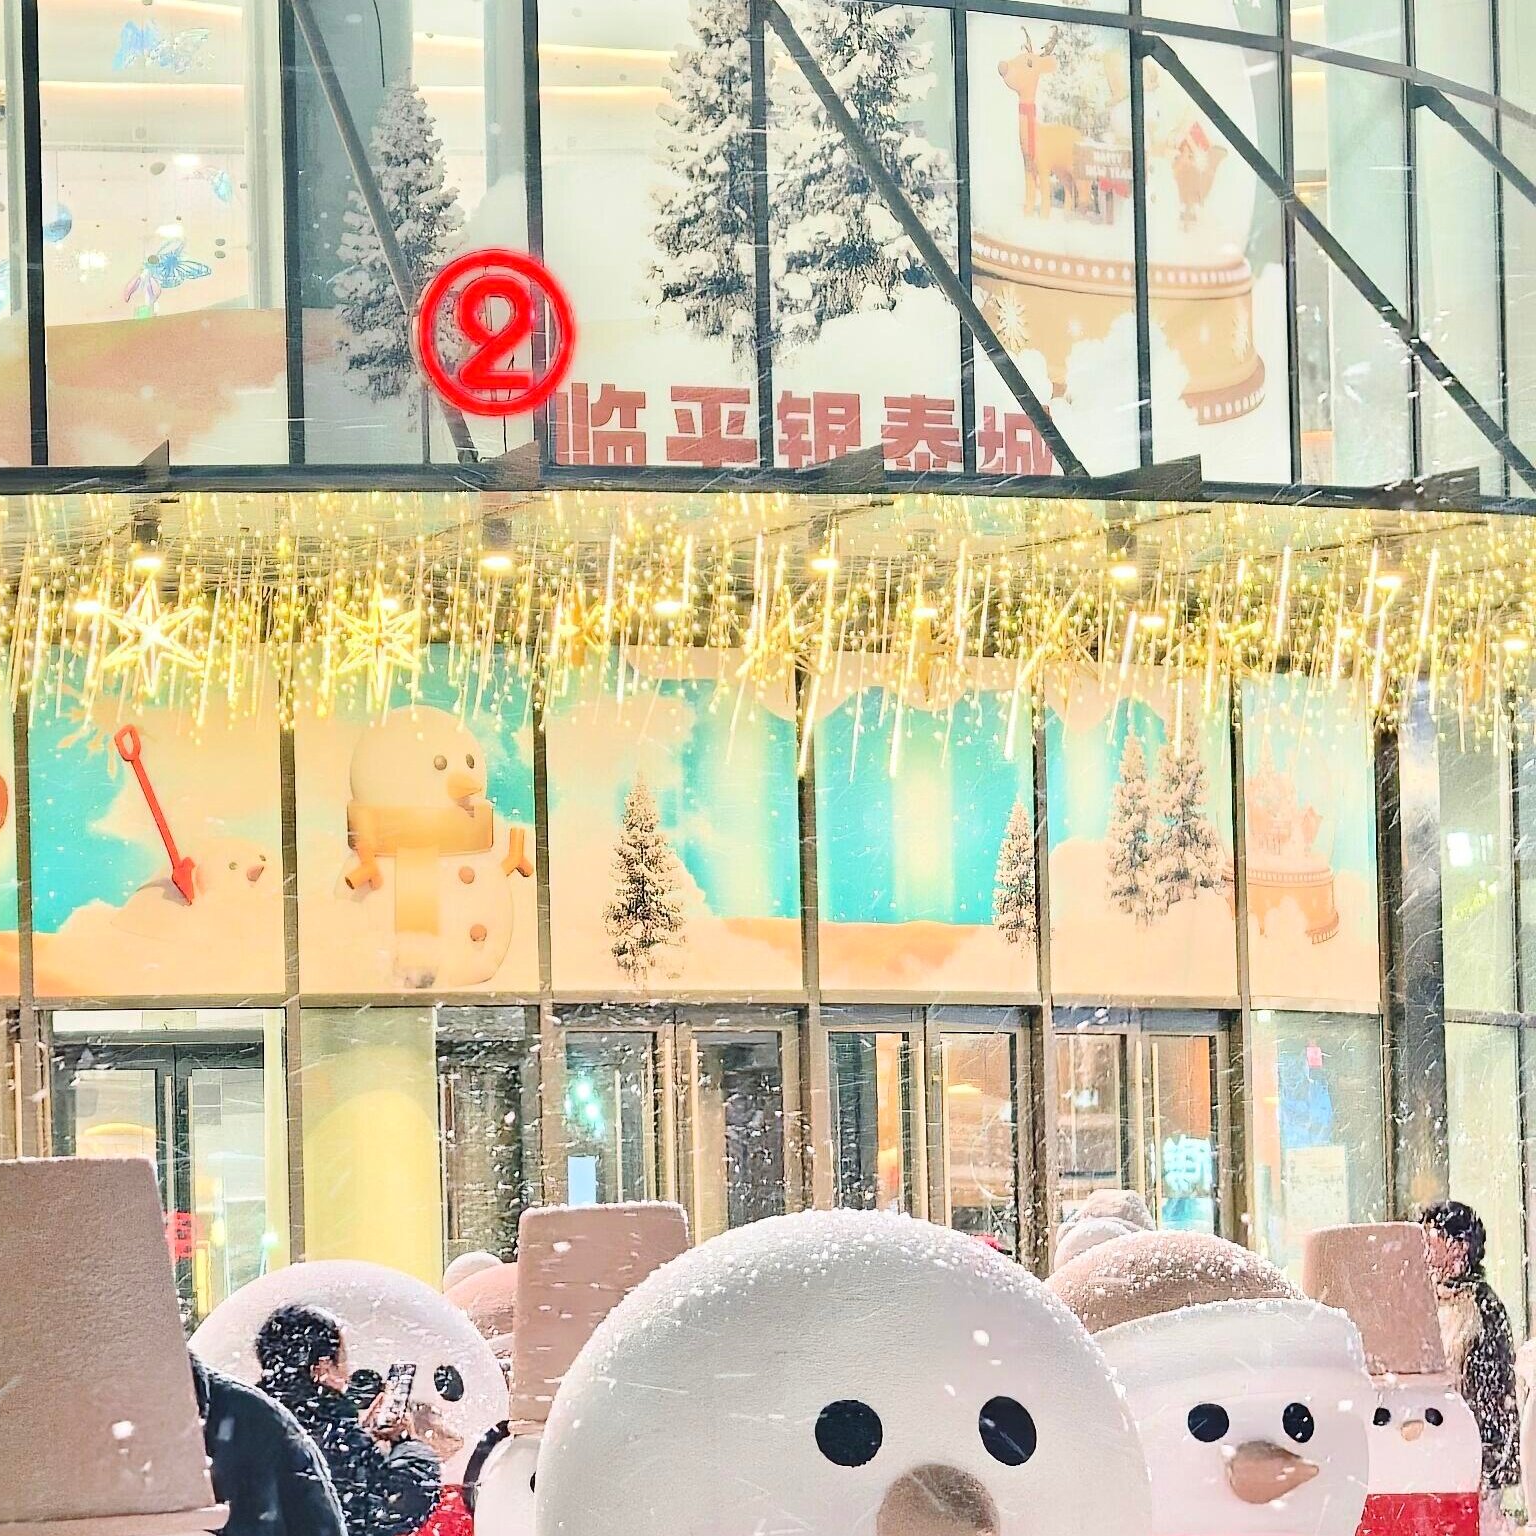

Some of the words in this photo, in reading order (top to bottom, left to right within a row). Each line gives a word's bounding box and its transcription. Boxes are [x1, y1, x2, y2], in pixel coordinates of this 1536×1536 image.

[555, 383, 1055, 475] 临平银泰城
